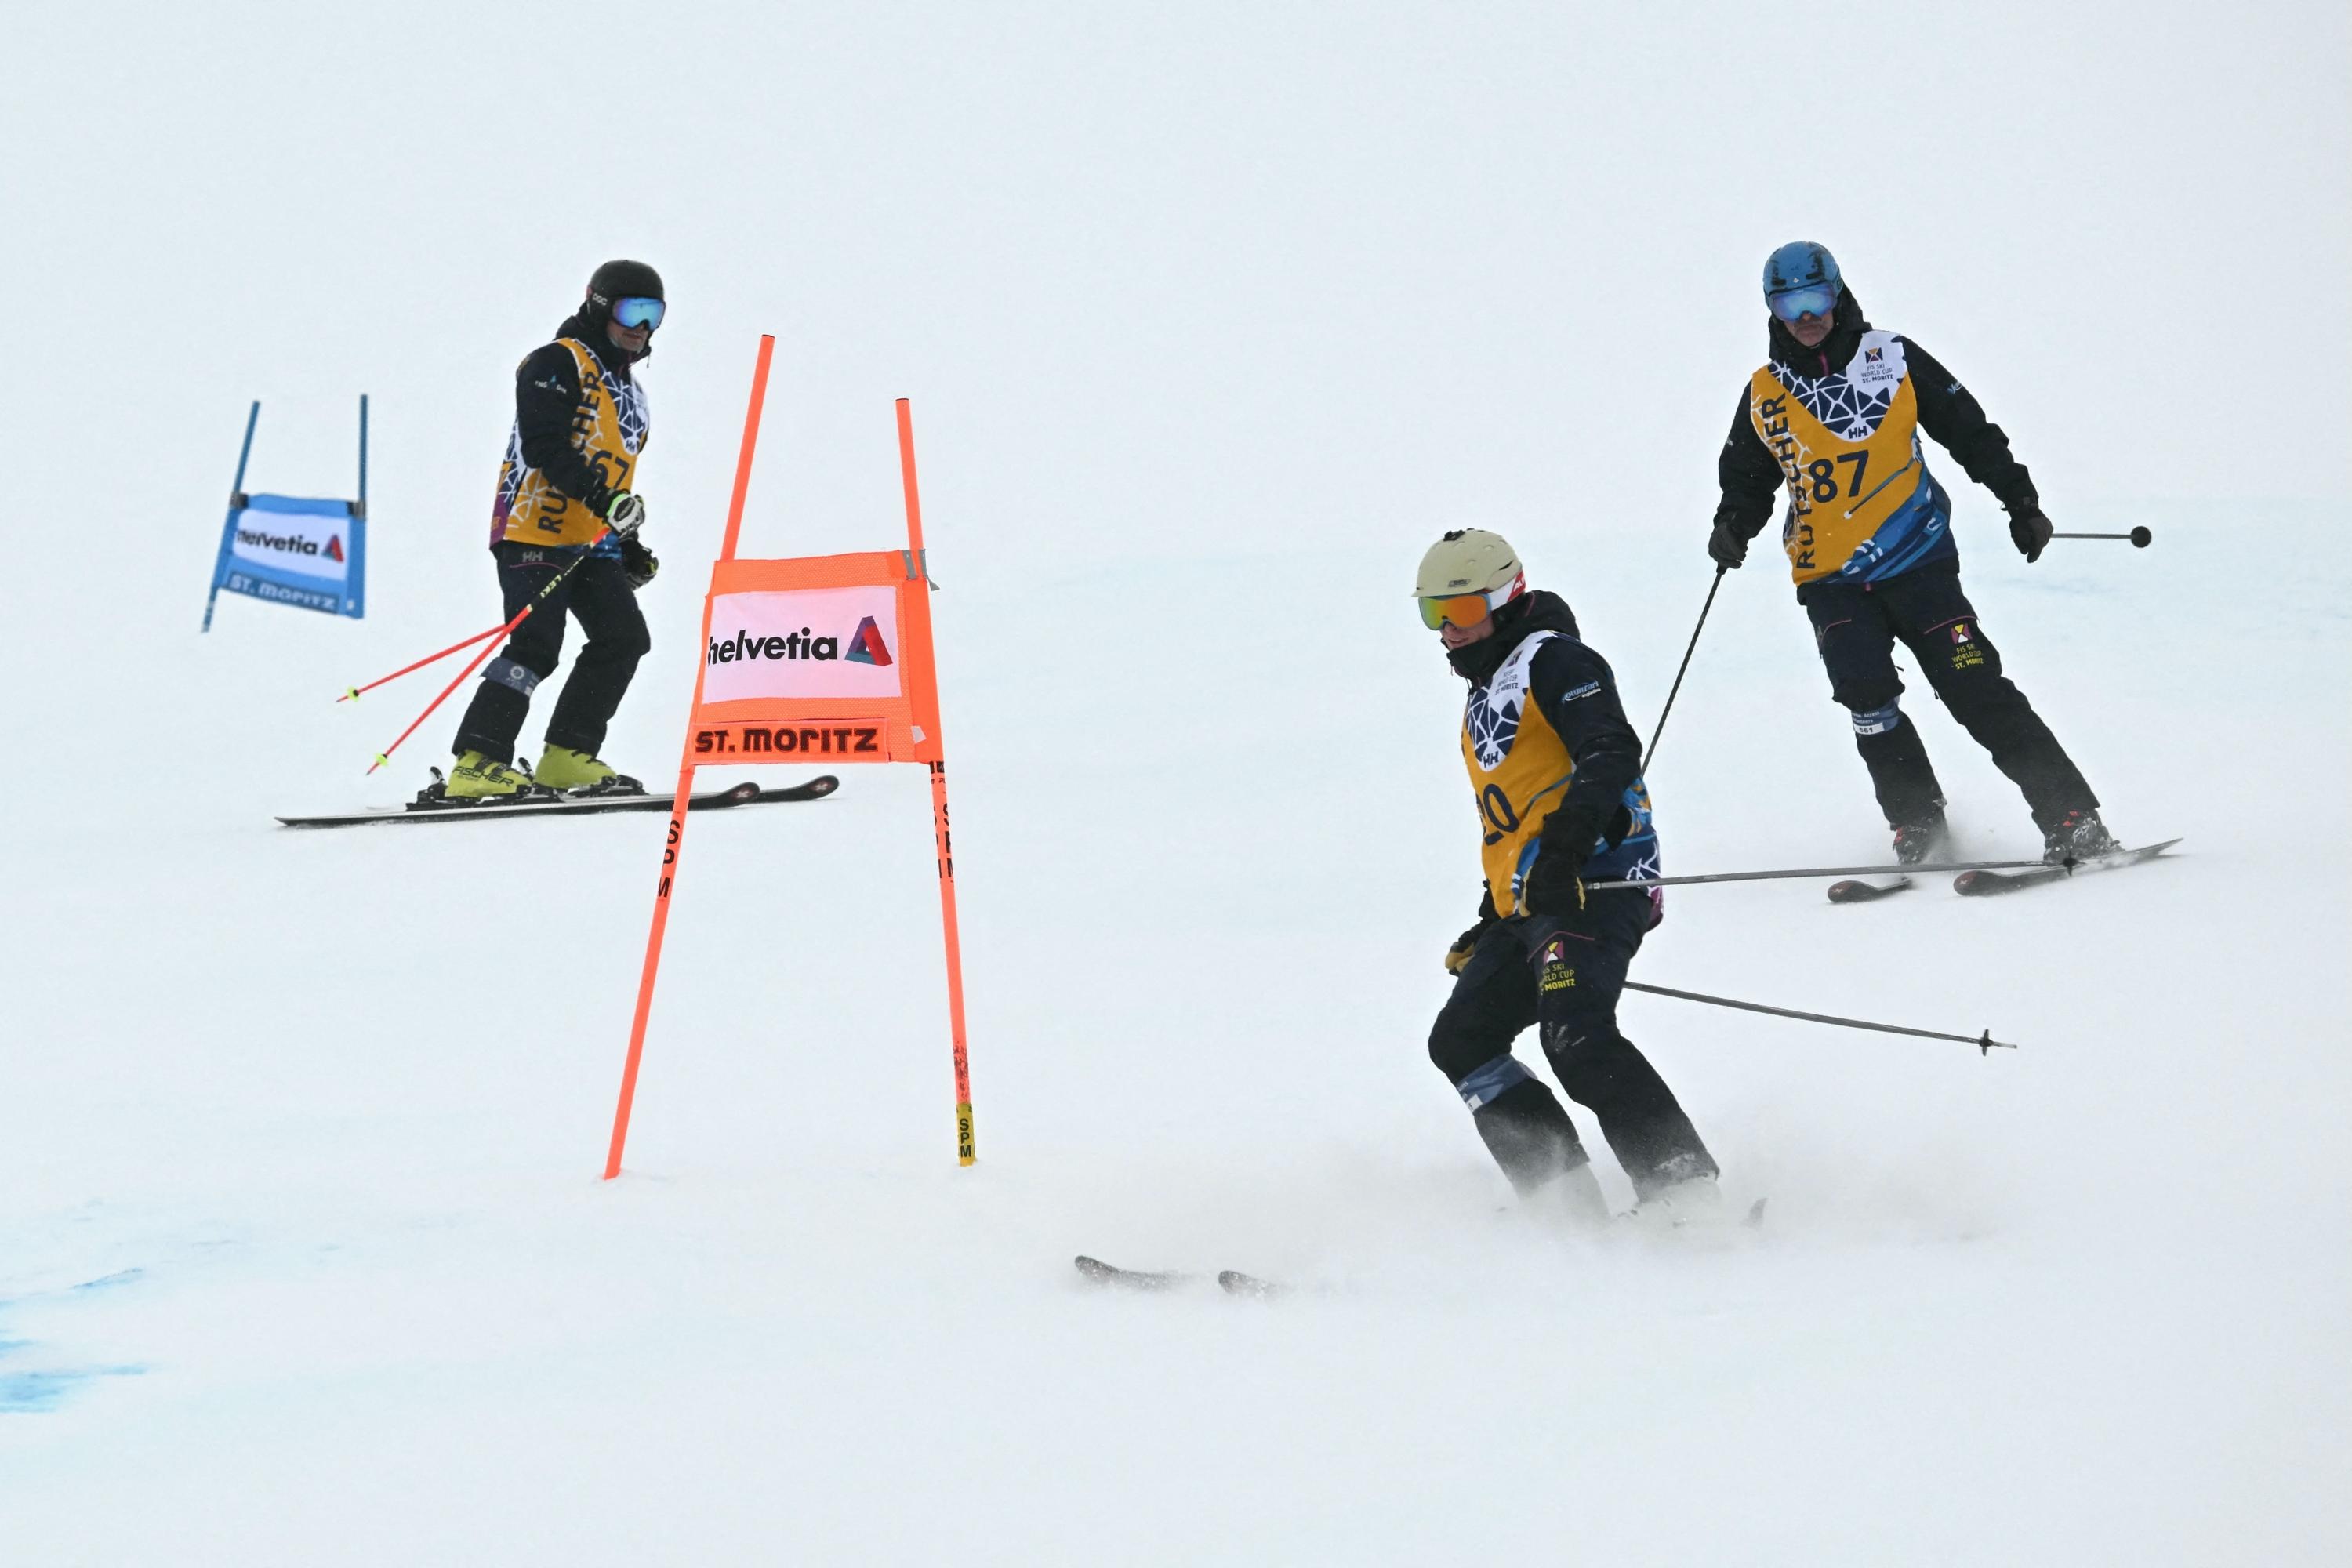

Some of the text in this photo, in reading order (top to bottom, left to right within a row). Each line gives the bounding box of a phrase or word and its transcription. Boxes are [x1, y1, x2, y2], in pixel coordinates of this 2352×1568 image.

[1861, 369, 1881, 378] WORLD
[1847, 425, 1868, 440] HH
[590, 450, 630, 491] 67
[1808, 449, 1869, 503] 87
[708, 627, 837, 667] helvetia
[695, 728, 878, 753] ST. MORITZ
[1483, 750, 1499, 768] HH
[452, 766, 514, 787] FISCHER
[1559, 969, 1575, 978] CUP
[1544, 978, 1576, 992] MORITZ
[959, 1118, 972, 1158] SPM
